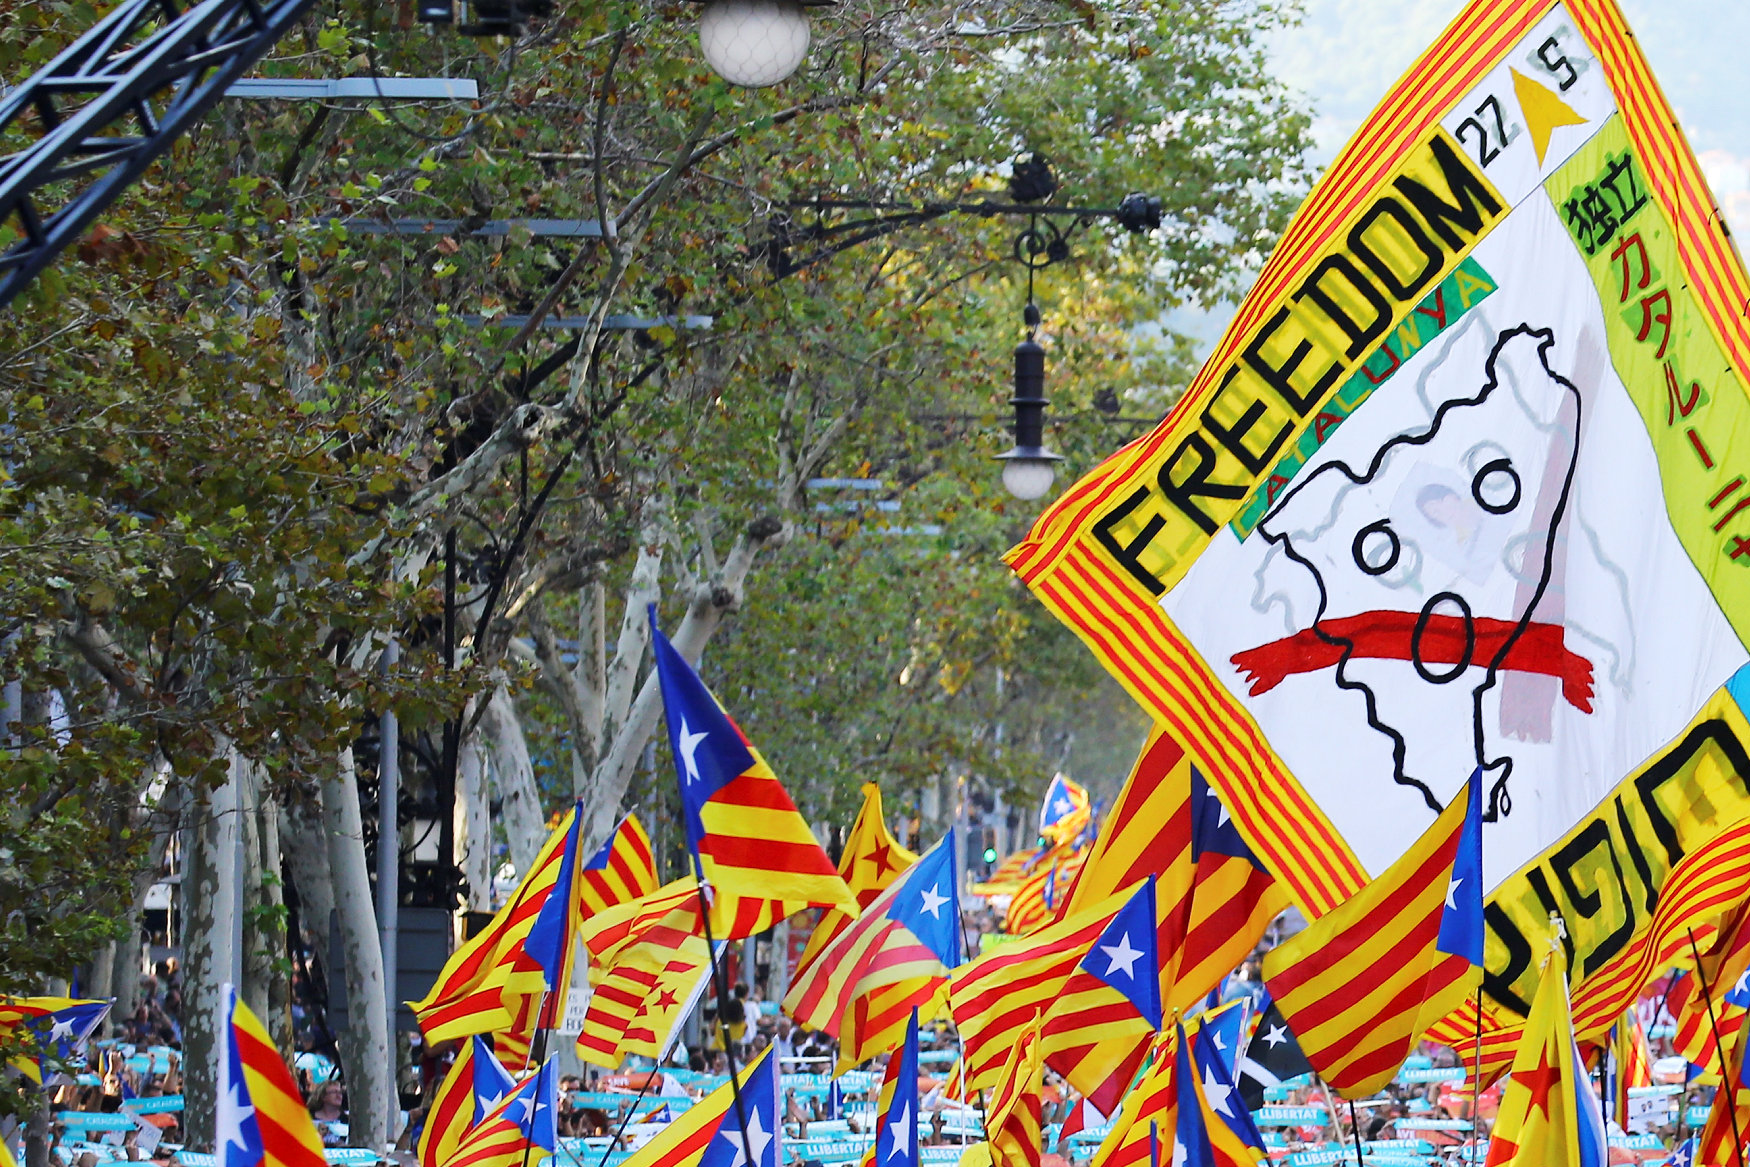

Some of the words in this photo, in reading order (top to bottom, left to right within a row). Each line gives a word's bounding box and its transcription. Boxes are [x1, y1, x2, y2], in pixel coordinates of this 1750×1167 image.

[1092, 135, 1511, 596] FREEDOM
[1233, 268, 1494, 540] CATALUNYA
[1260, 1109, 1317, 1120] LLIBERTAT
